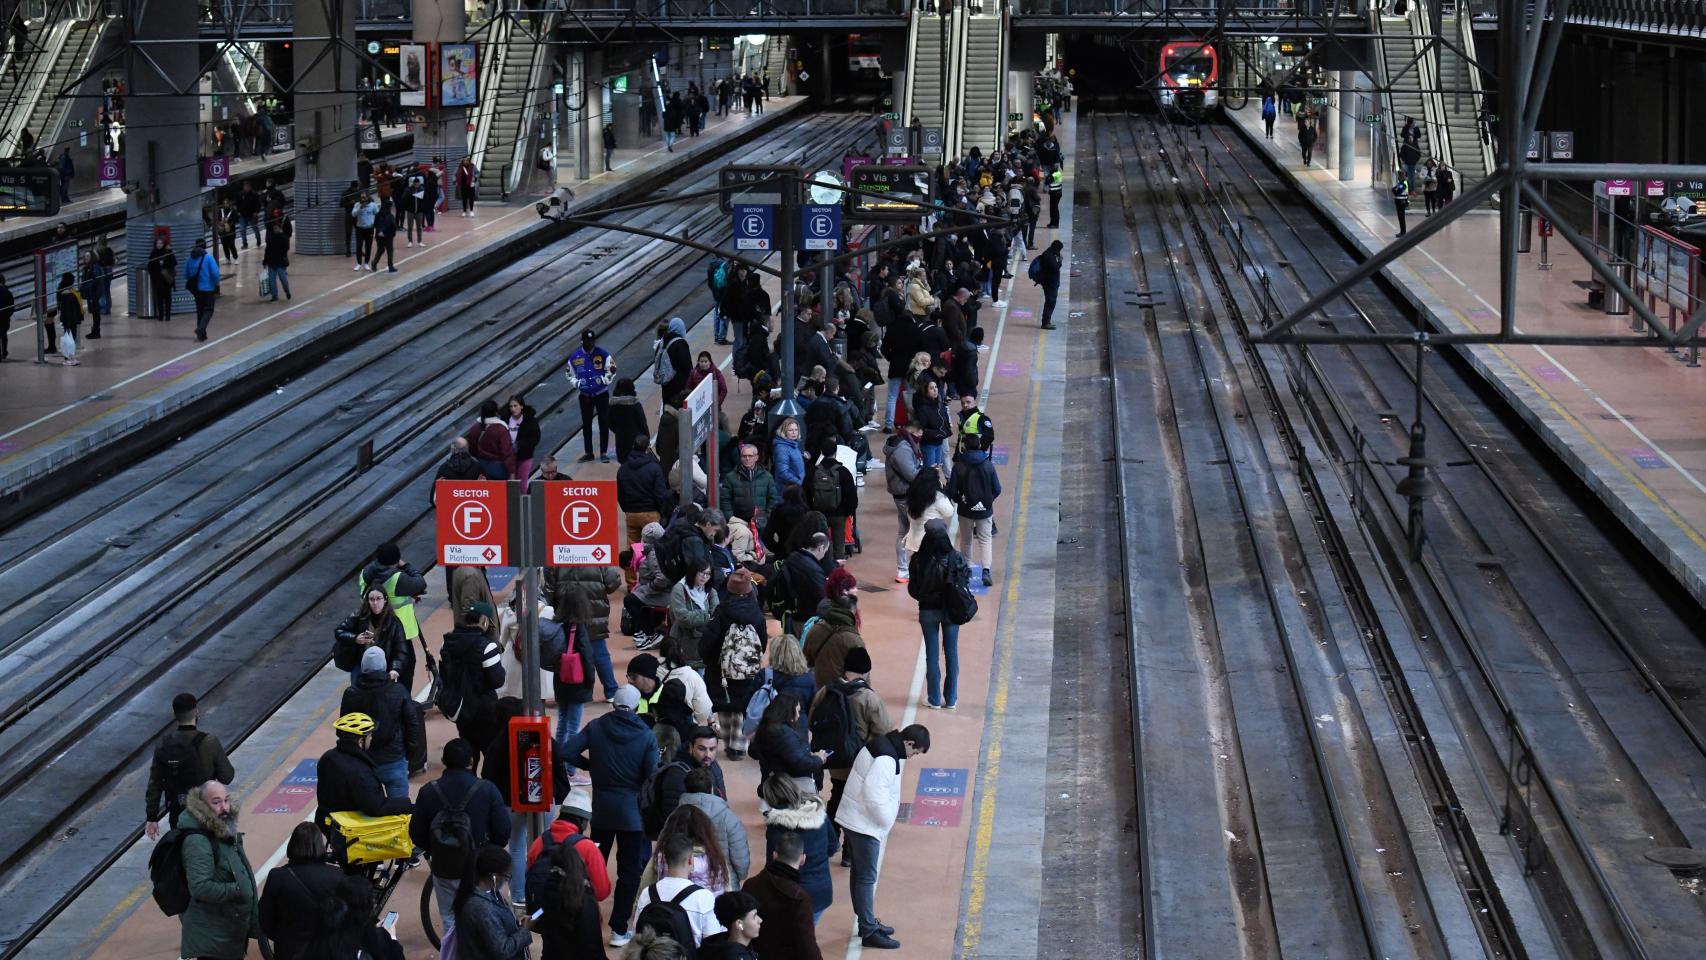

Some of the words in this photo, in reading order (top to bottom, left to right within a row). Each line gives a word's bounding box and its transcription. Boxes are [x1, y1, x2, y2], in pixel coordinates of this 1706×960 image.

[748, 218, 758, 232] E
[816, 218, 827, 233] E
[452, 489, 489, 498] SECTOR
[563, 488, 598, 496] SECTOR
[464, 507, 482, 533] F
[572, 507, 590, 534] F
[450, 554, 478, 564] Platform
[486, 550, 492, 558] 4
[558, 554, 588, 564] Platform
[595, 550, 602, 558] 3
